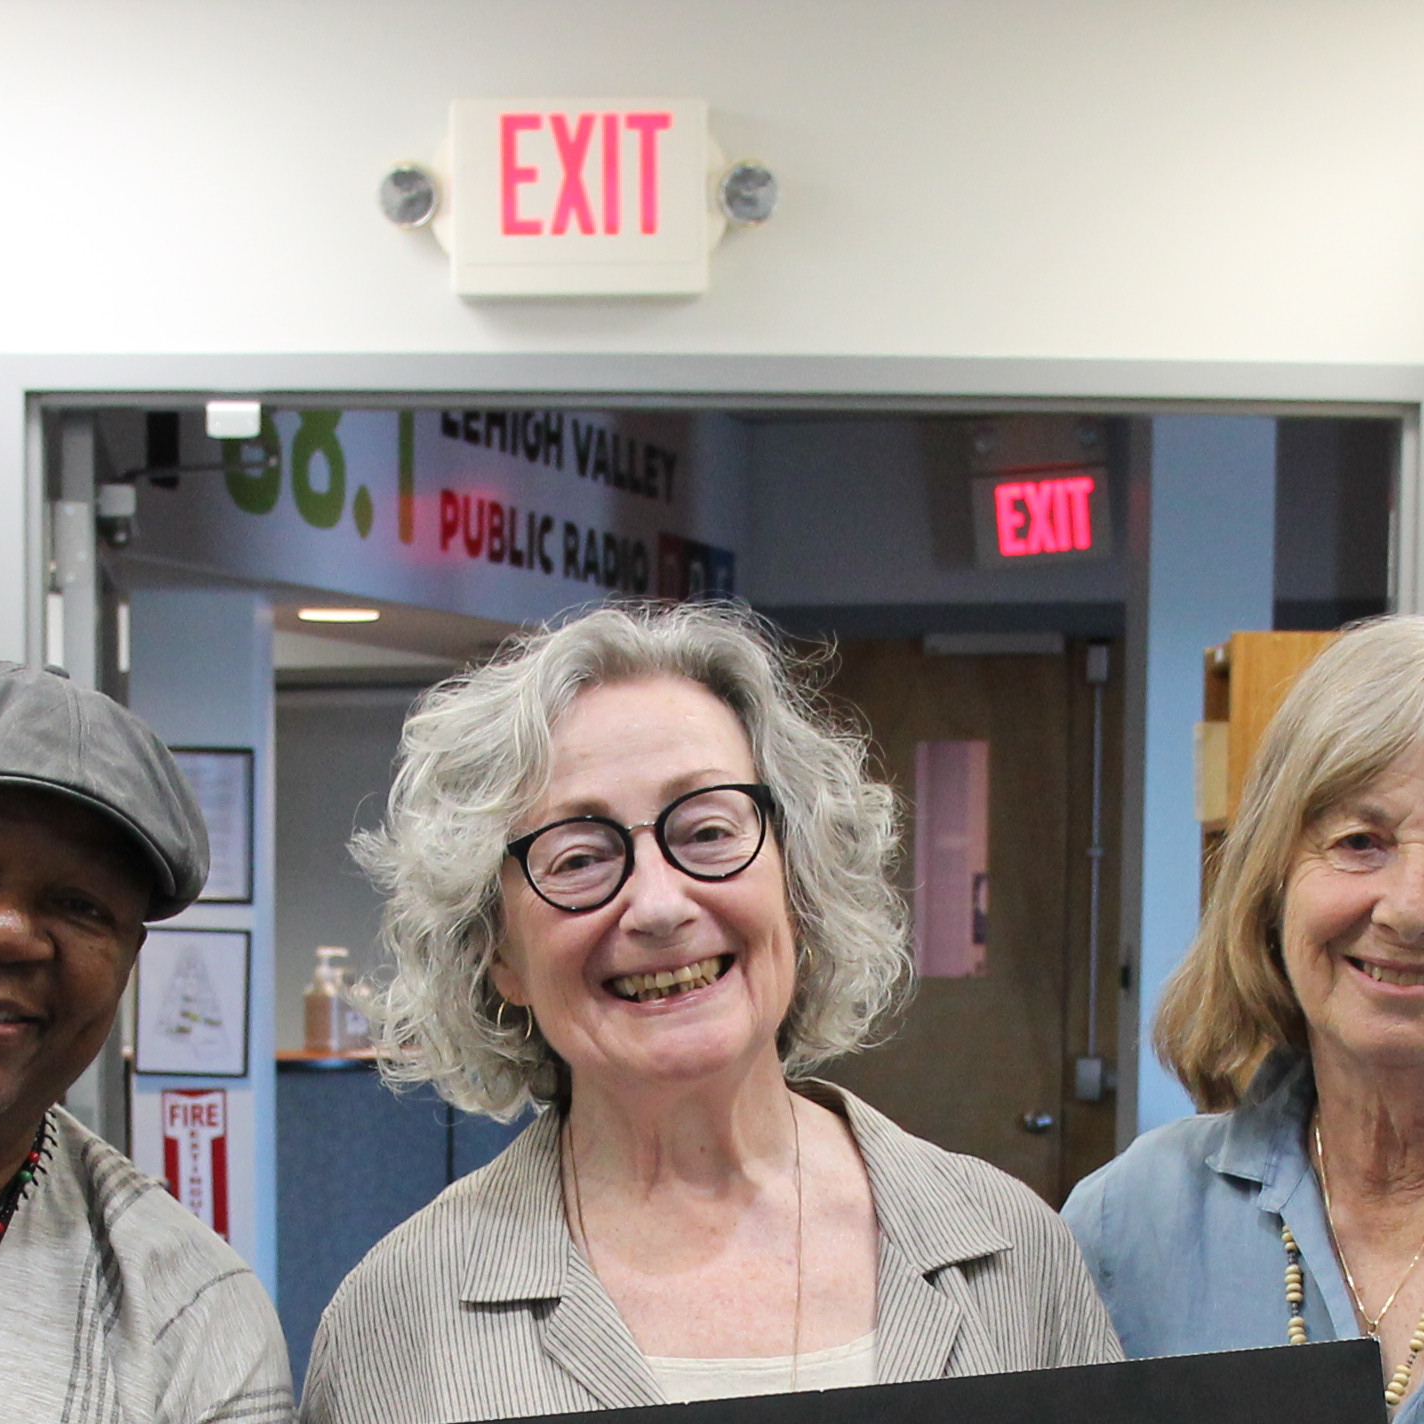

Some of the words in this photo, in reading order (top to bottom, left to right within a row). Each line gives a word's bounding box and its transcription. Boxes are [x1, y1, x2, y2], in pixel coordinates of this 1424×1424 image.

[501, 114, 672, 235] EXIT
[440, 411, 564, 470] LEHIGH
[572, 416, 677, 502] VALLEY
[439, 488, 555, 575] PUBLIC
[562, 522, 650, 592] RADIO
[994, 477, 1094, 556] EXIT
[169, 1103, 221, 1128] FIRE
